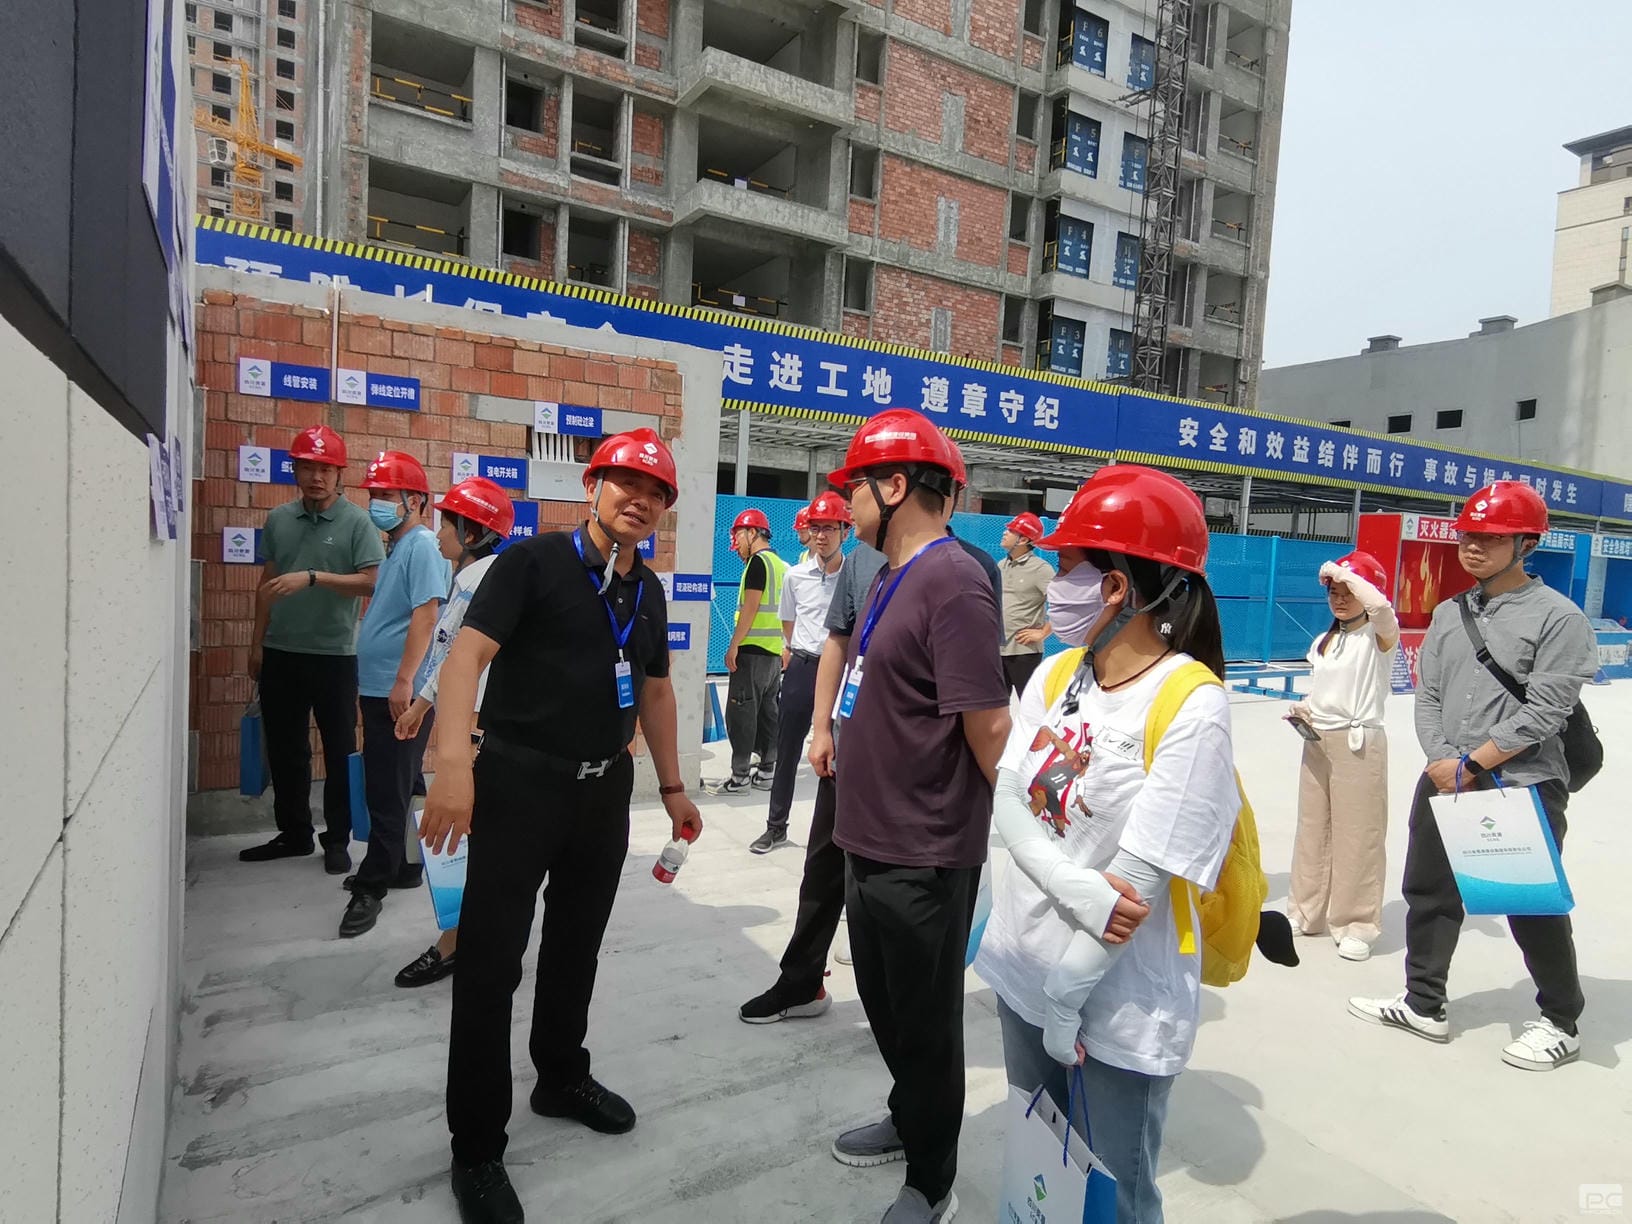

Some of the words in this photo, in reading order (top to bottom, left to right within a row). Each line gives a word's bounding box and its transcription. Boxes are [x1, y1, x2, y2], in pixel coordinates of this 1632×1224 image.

[283, 374, 318, 391] 线管安装
[721, 343, 892, 404] 走进工地
[920, 375, 1060, 430] 遵章守纪
[1179, 417, 1405, 477] 安全和效益结伴而行
[487, 466, 518, 479] 强电开关箱
